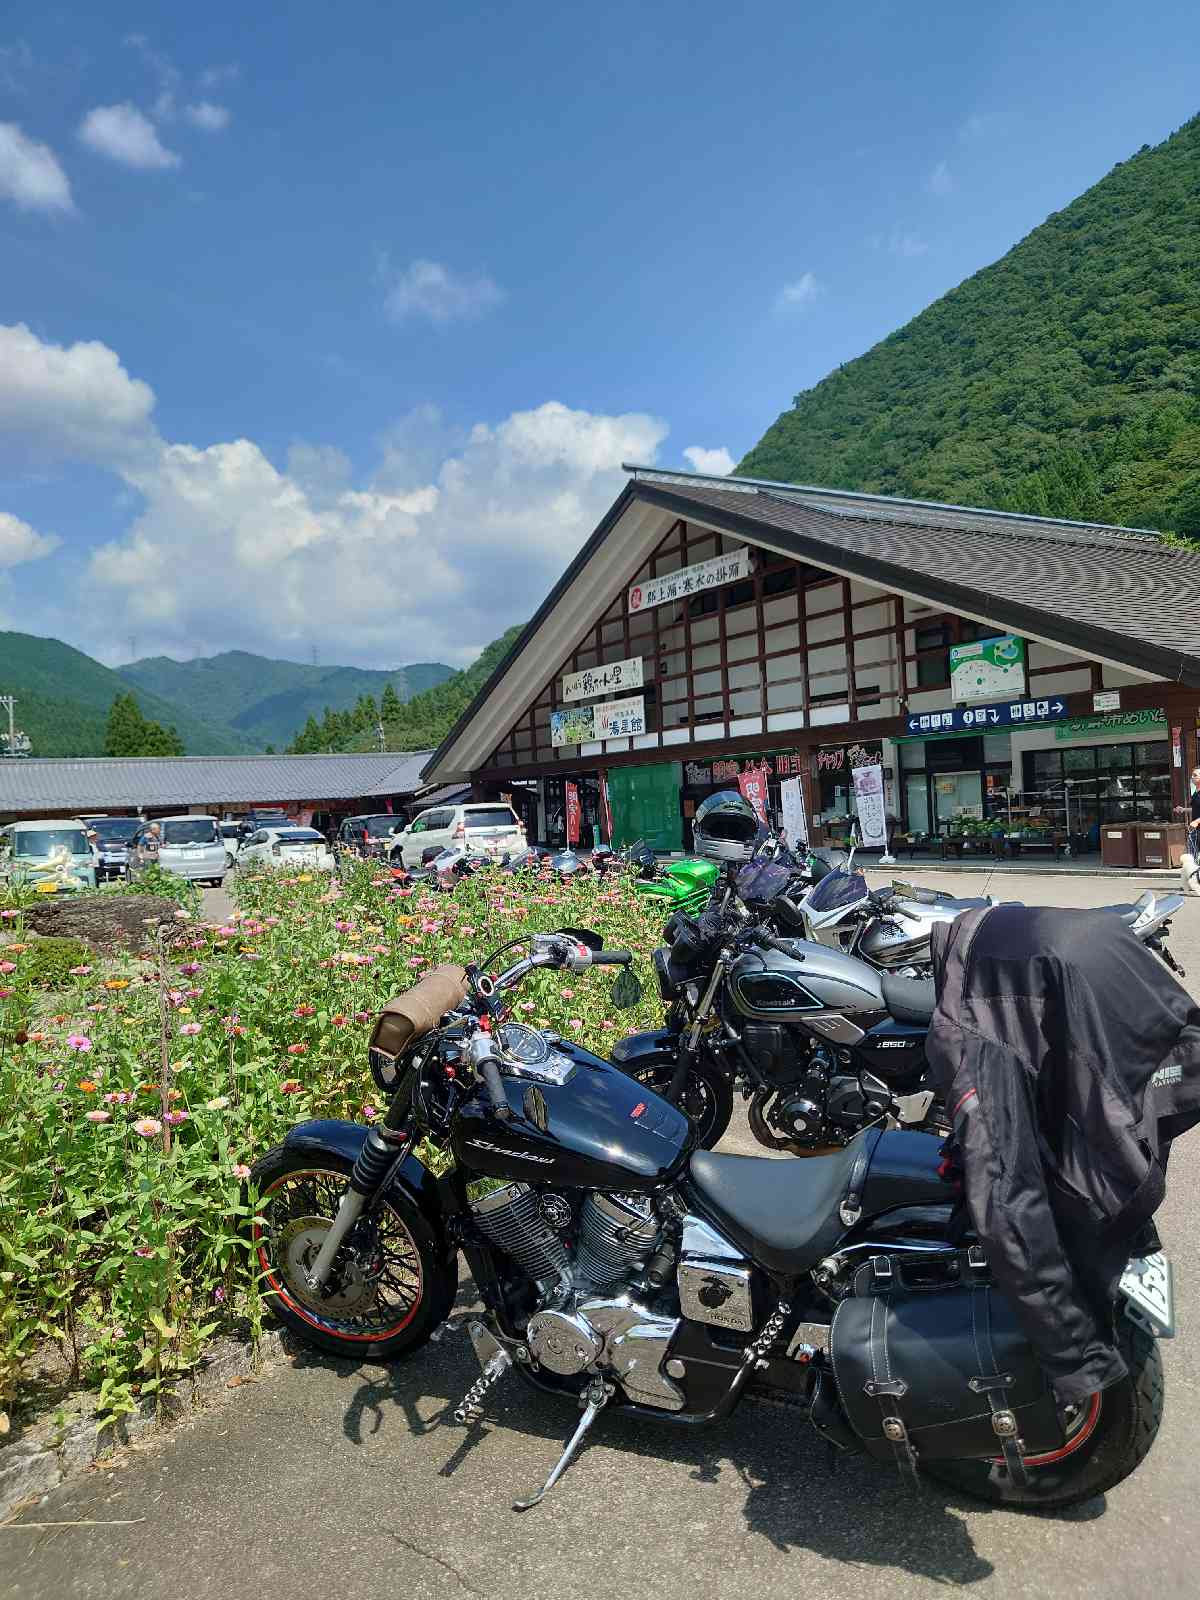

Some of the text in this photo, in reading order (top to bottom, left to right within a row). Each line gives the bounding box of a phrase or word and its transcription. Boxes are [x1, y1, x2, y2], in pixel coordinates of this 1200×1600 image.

[608, 717, 643, 736] 湯星館
[464, 1138, 557, 1164] Shadow
[710, 1313, 745, 1326] HONDA
